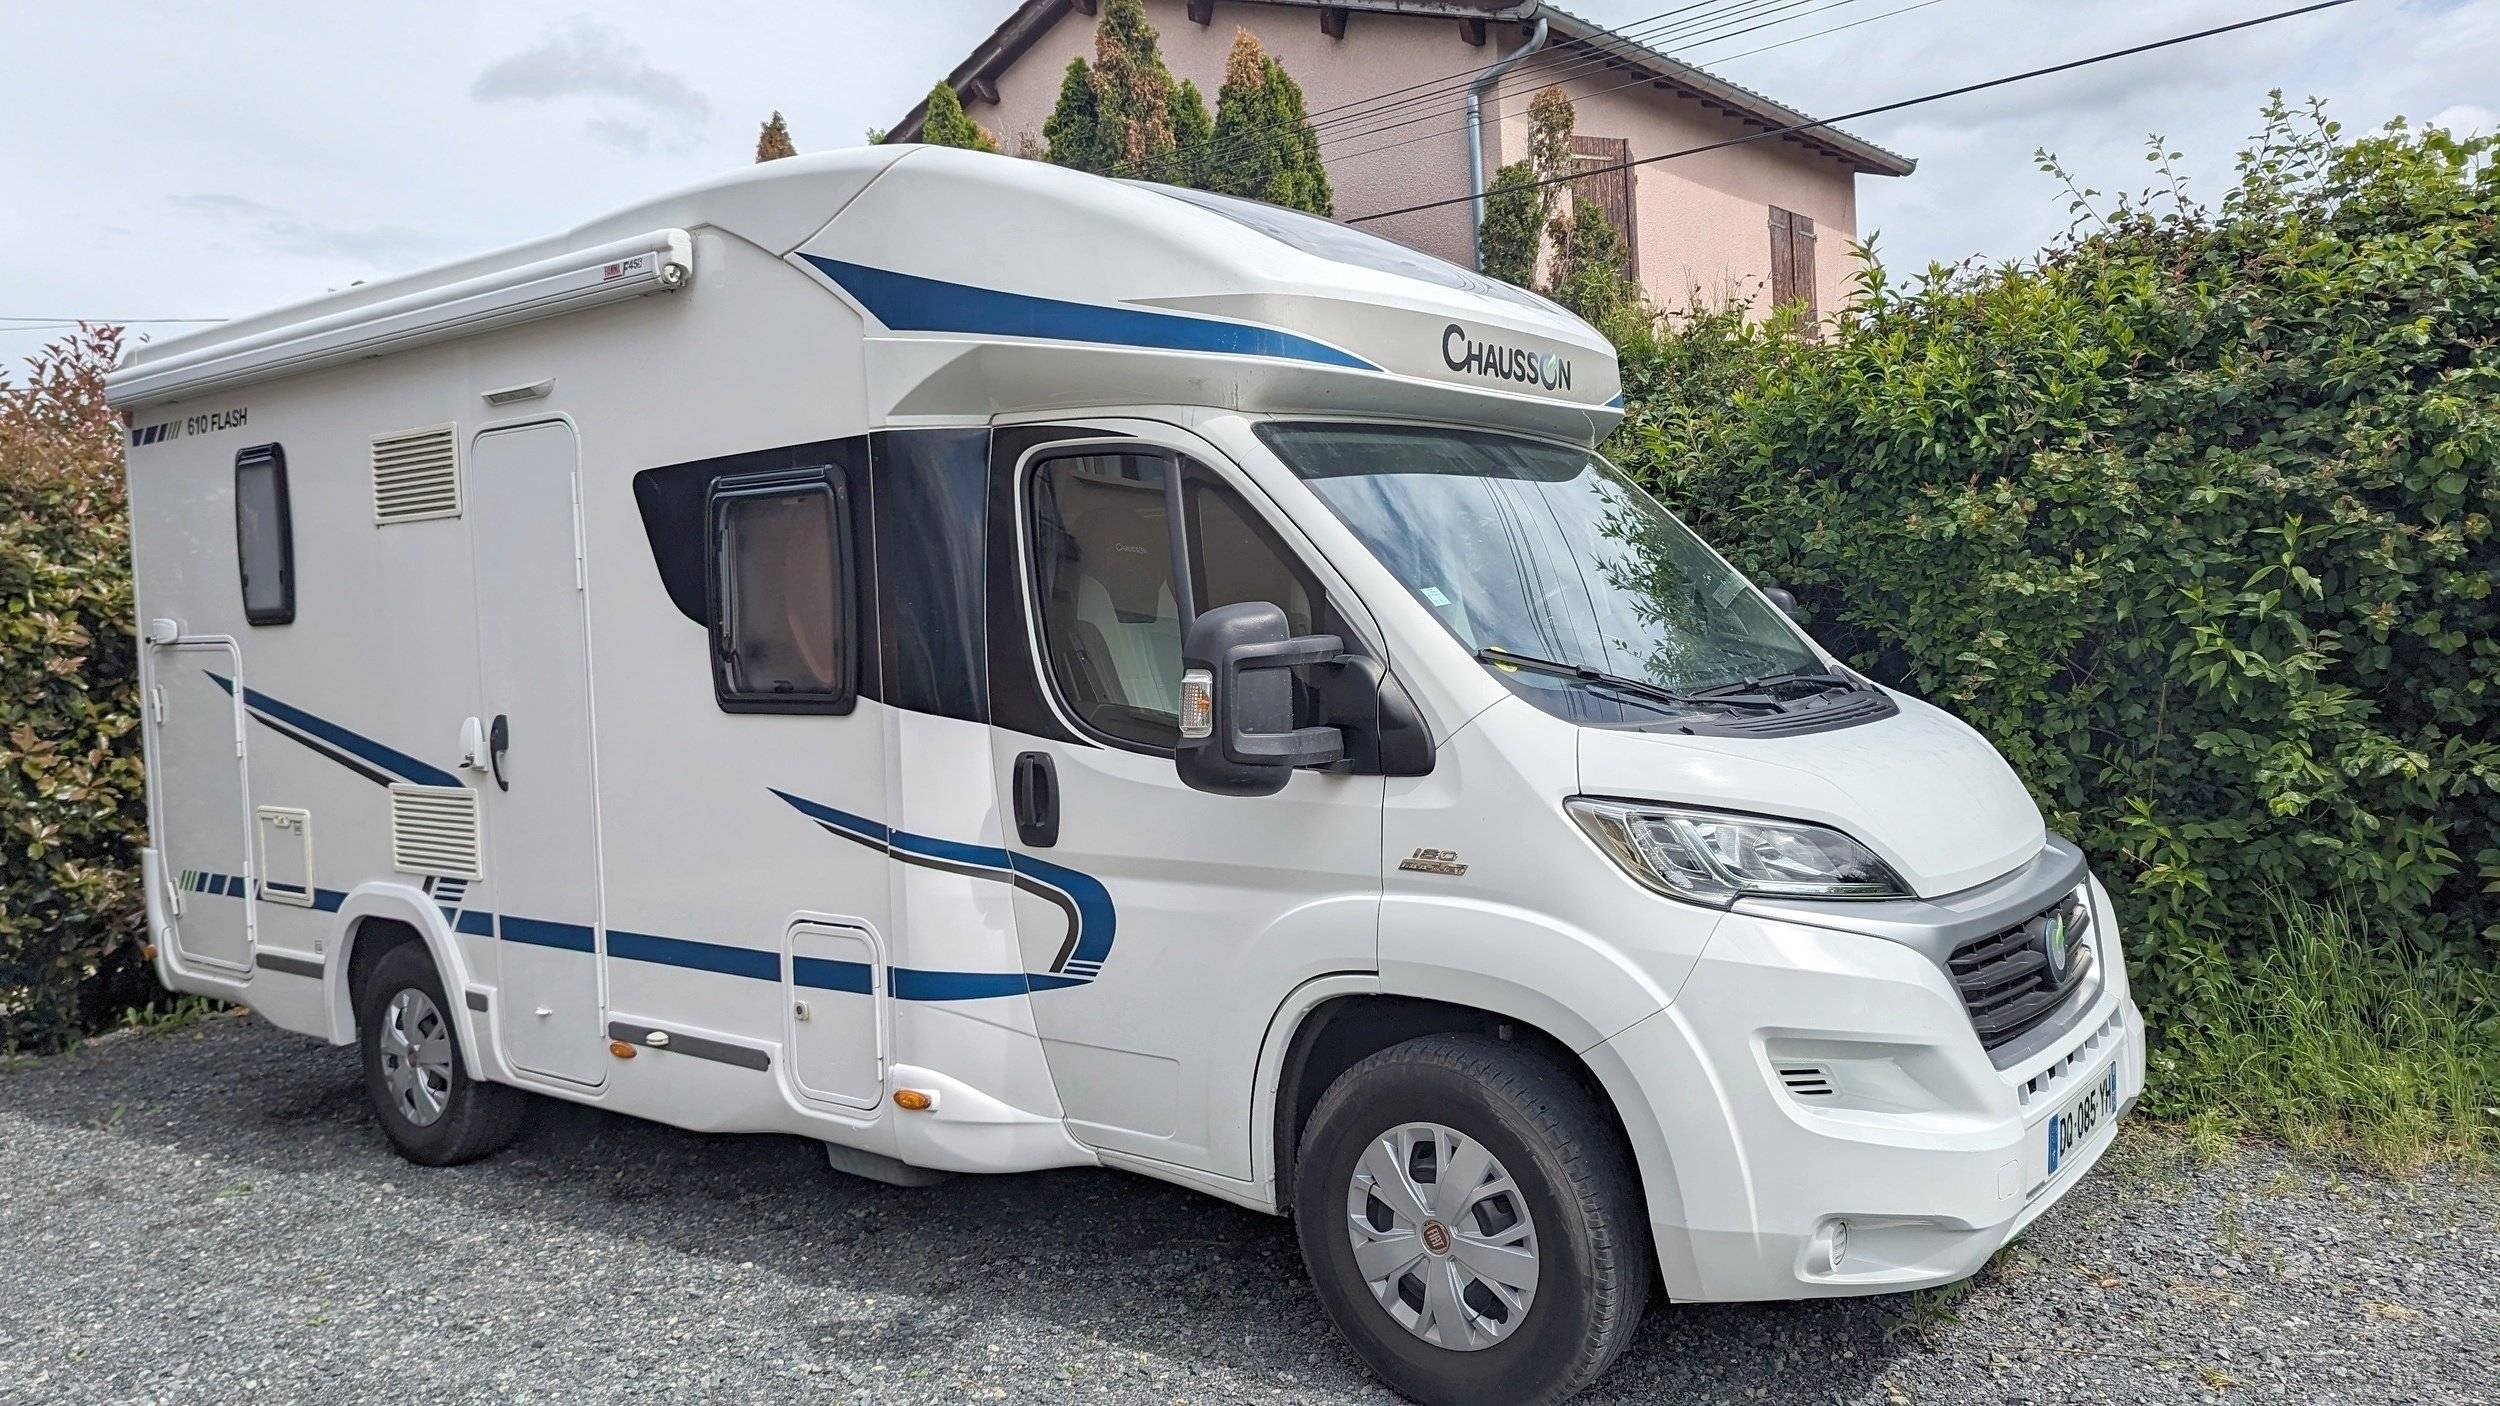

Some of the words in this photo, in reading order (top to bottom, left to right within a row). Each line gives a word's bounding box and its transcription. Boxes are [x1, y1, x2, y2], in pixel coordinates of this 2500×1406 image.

[1442, 323, 1572, 391] CHAUSSON
[187, 414, 208, 436] 610
[211, 407, 248, 432] FLASH
[1427, 1227, 1445, 1248] FIAT
